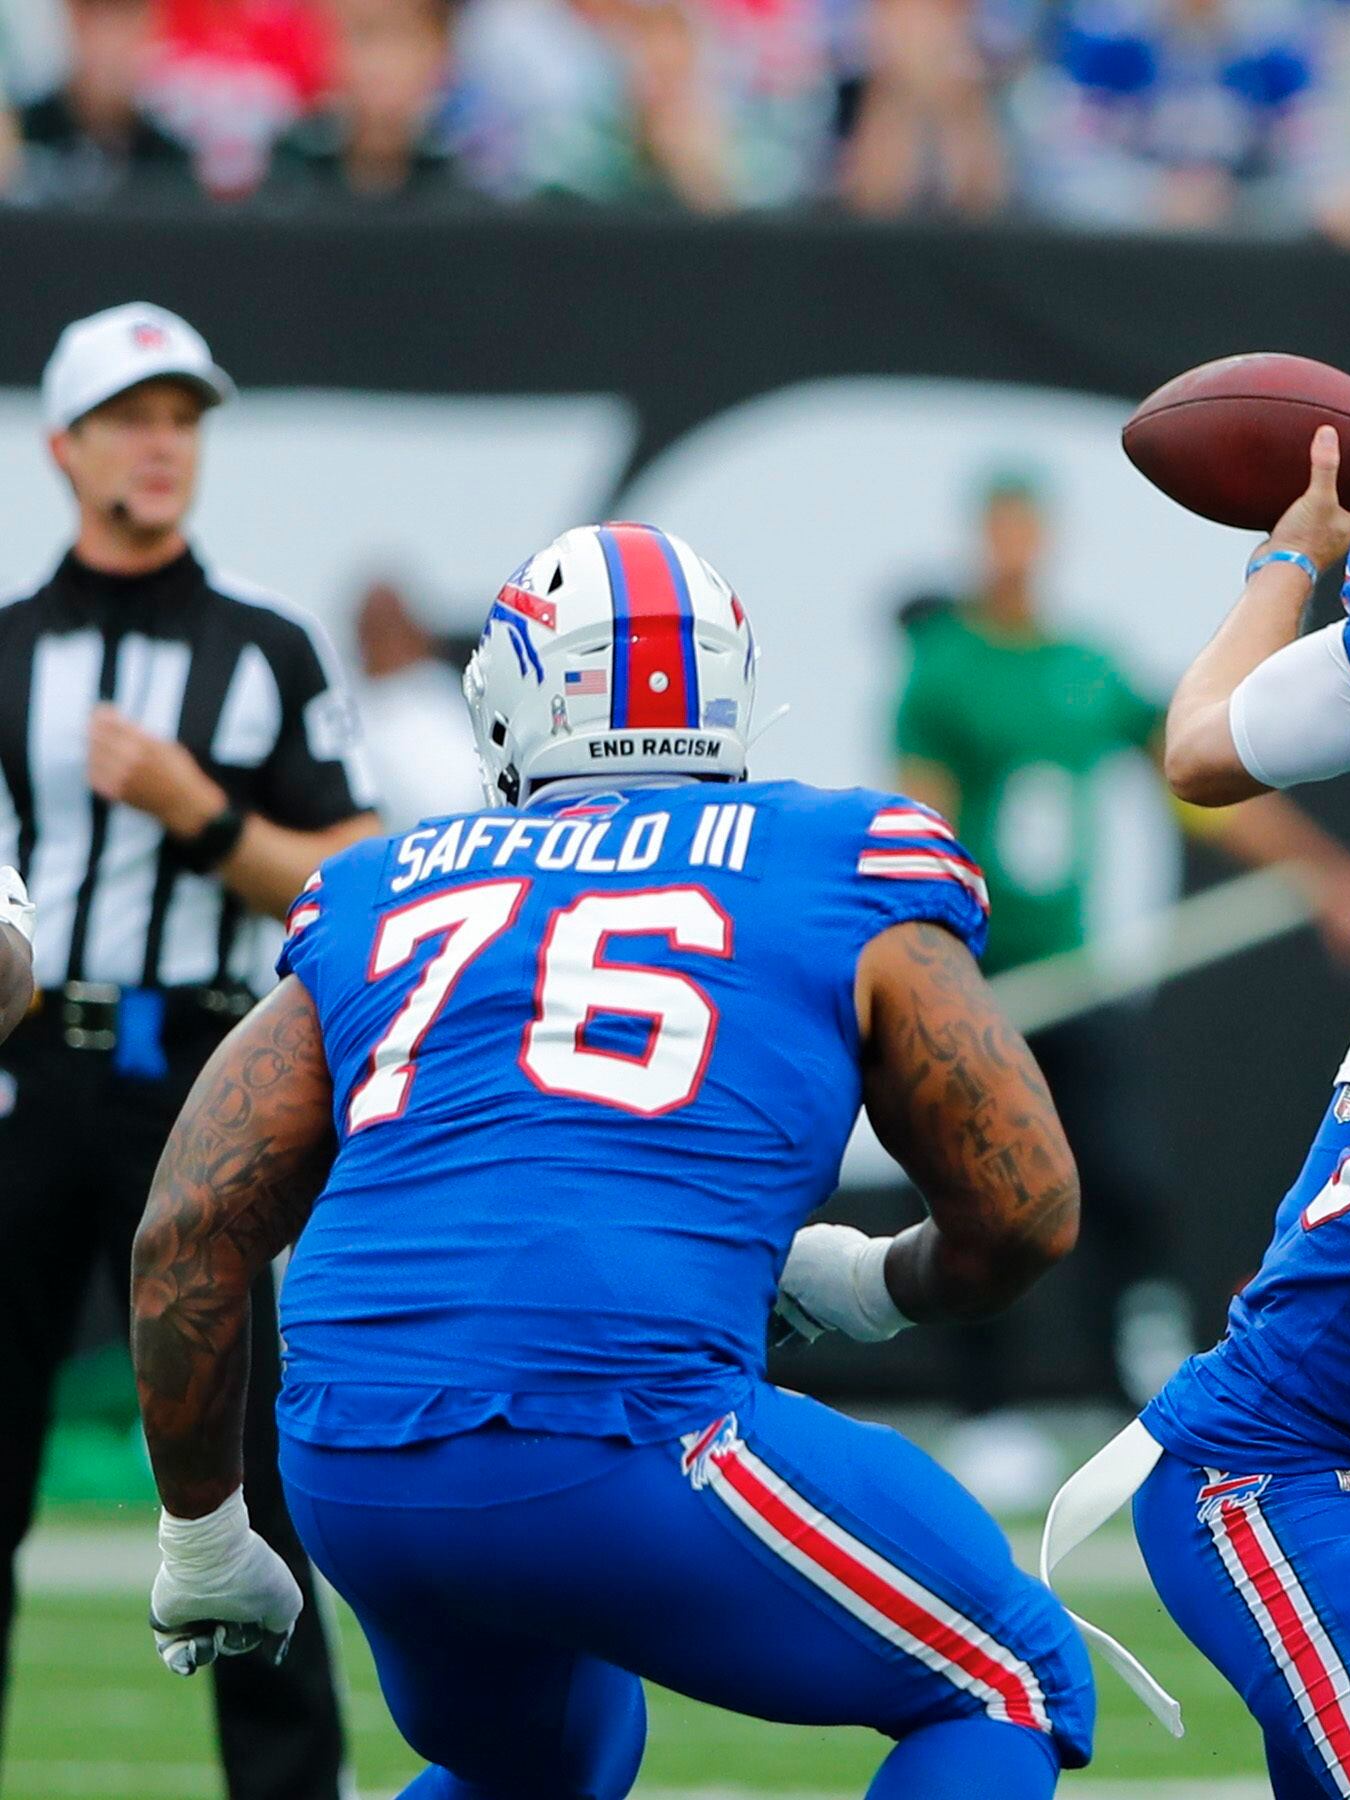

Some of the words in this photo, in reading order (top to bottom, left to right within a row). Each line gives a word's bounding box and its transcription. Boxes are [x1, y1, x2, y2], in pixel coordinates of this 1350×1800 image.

[588, 739, 635, 759] END
[642, 738, 721, 758] RACISM
[391, 811, 671, 893] SAFFOLD
[689, 803, 756, 872] III
[346, 877, 733, 1135] 76
